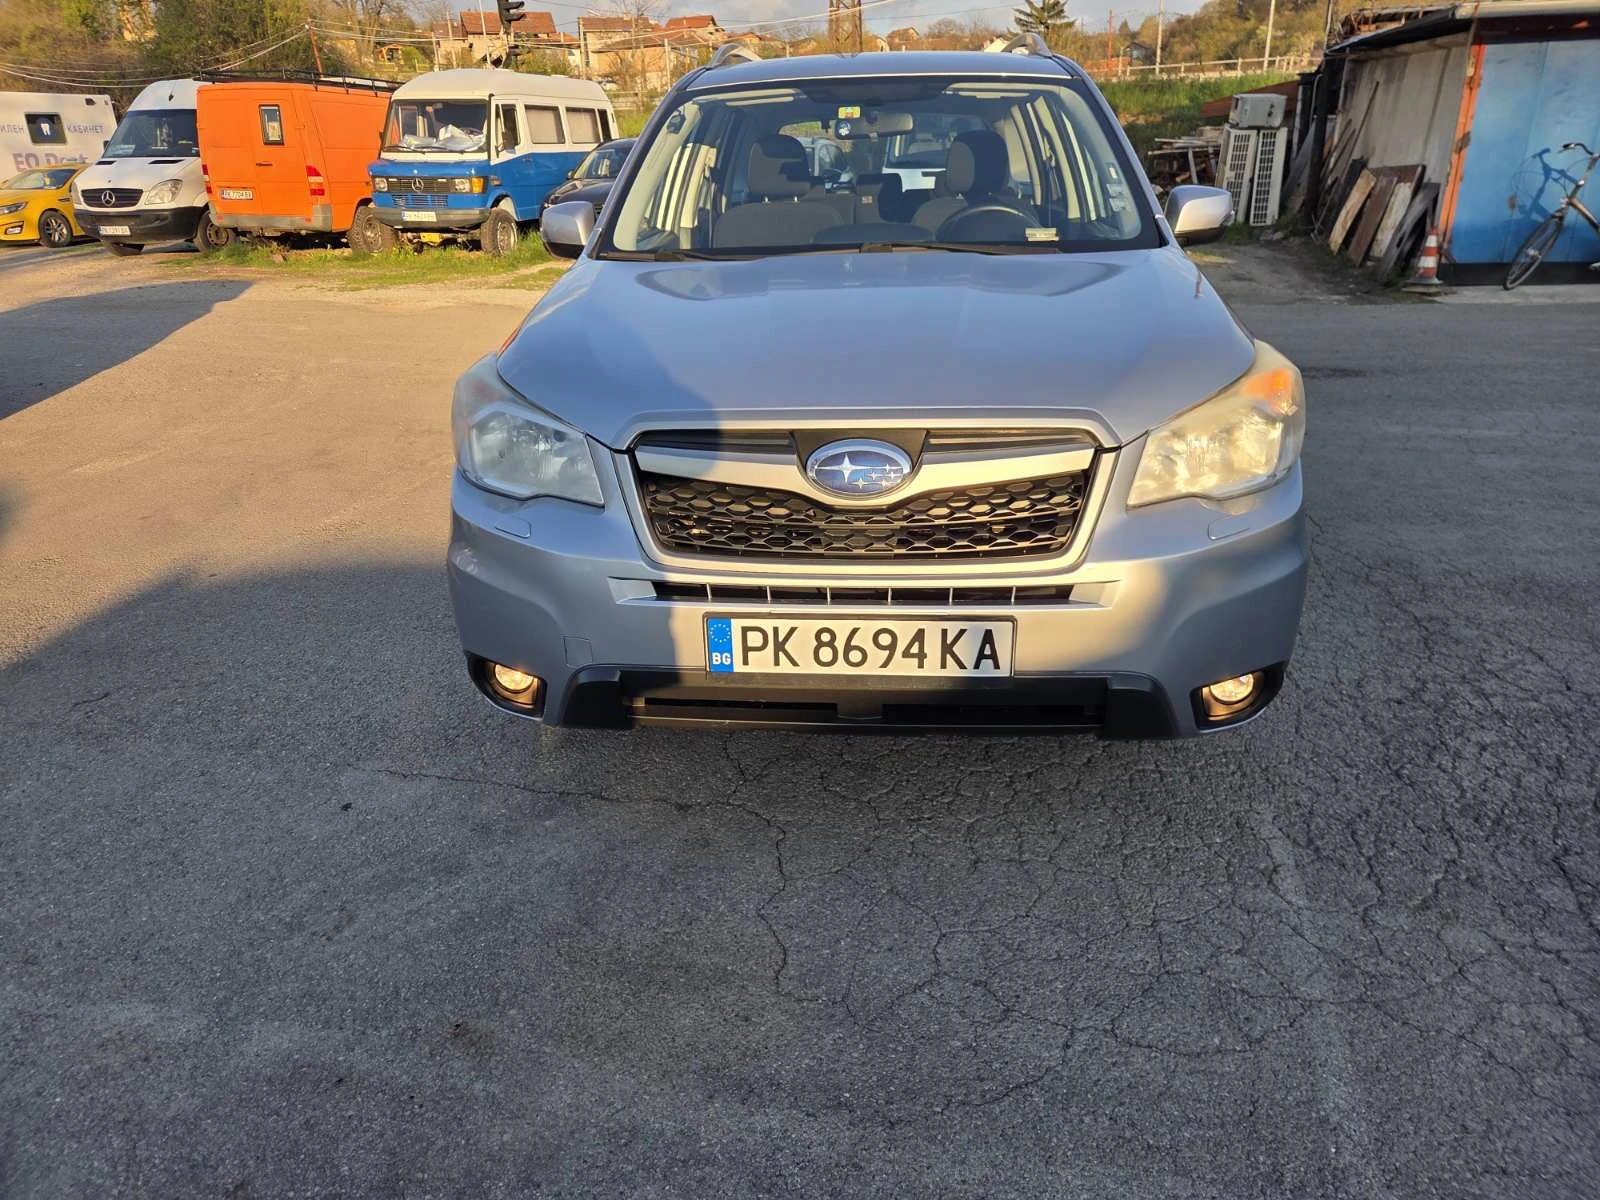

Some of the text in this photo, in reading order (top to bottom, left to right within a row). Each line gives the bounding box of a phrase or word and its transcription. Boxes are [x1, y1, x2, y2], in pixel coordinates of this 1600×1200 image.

[66, 124, 104, 134] КАБИНЕТ
[740, 625, 1001, 671] PK 8694 KA
[712, 652, 731, 666] BG
